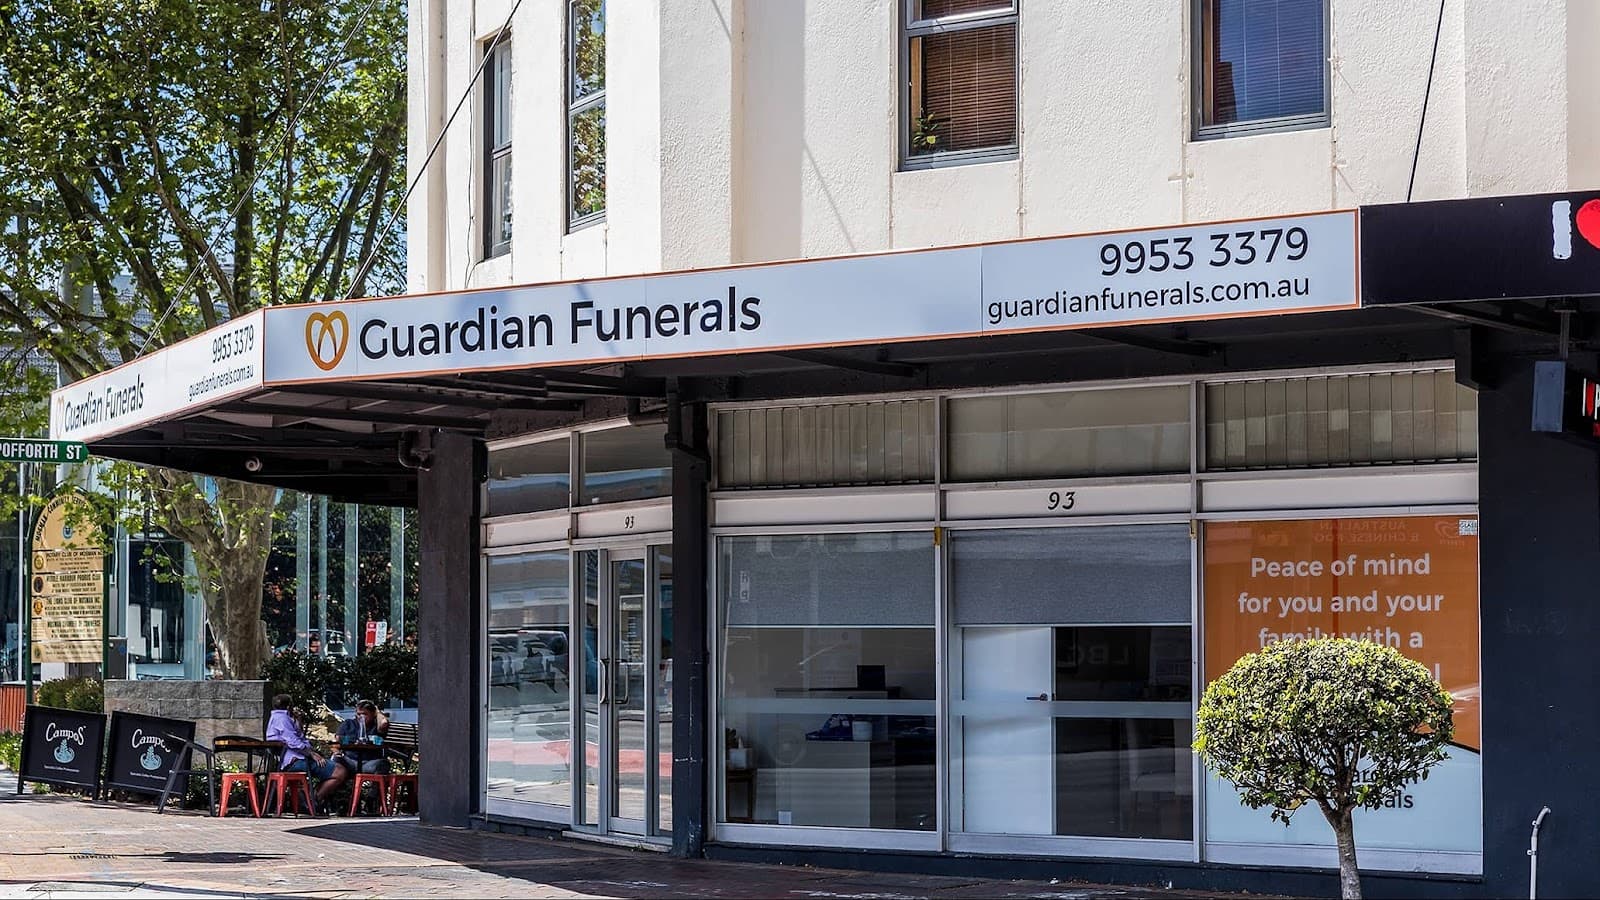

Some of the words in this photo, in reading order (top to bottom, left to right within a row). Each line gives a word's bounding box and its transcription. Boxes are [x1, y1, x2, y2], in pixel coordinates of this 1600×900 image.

[1099, 236, 1194, 276] 9953
[1208, 226, 1309, 268] 3379
[987, 277, 1310, 325] guardianfunerals.com.au
[358, 304, 554, 361] Guardian
[570, 286, 762, 345] Funerals
[212, 330, 232, 364] 9953
[233, 324, 255, 356] 3379
[188, 365, 254, 401] guardianfunerals.com.au
[63, 391, 103, 432] Guardian
[104, 373, 145, 421] Funerals
[0, 442, 59, 459] OFFORTH
[66, 444, 83, 460] ST
[1047, 491, 1075, 510] 93
[624, 515, 635, 529] 93
[1251, 557, 1324, 578] Peace
[1330, 554, 1358, 577] of
[1363, 553, 1431, 576] mind
[1238, 592, 1272, 614] for
[1277, 597, 1323, 619] you
[1330, 590, 1378, 613] and
[1386, 594, 1444, 618] your
[1408, 631, 1424, 649] a
[132, 729, 171, 752] Camp
